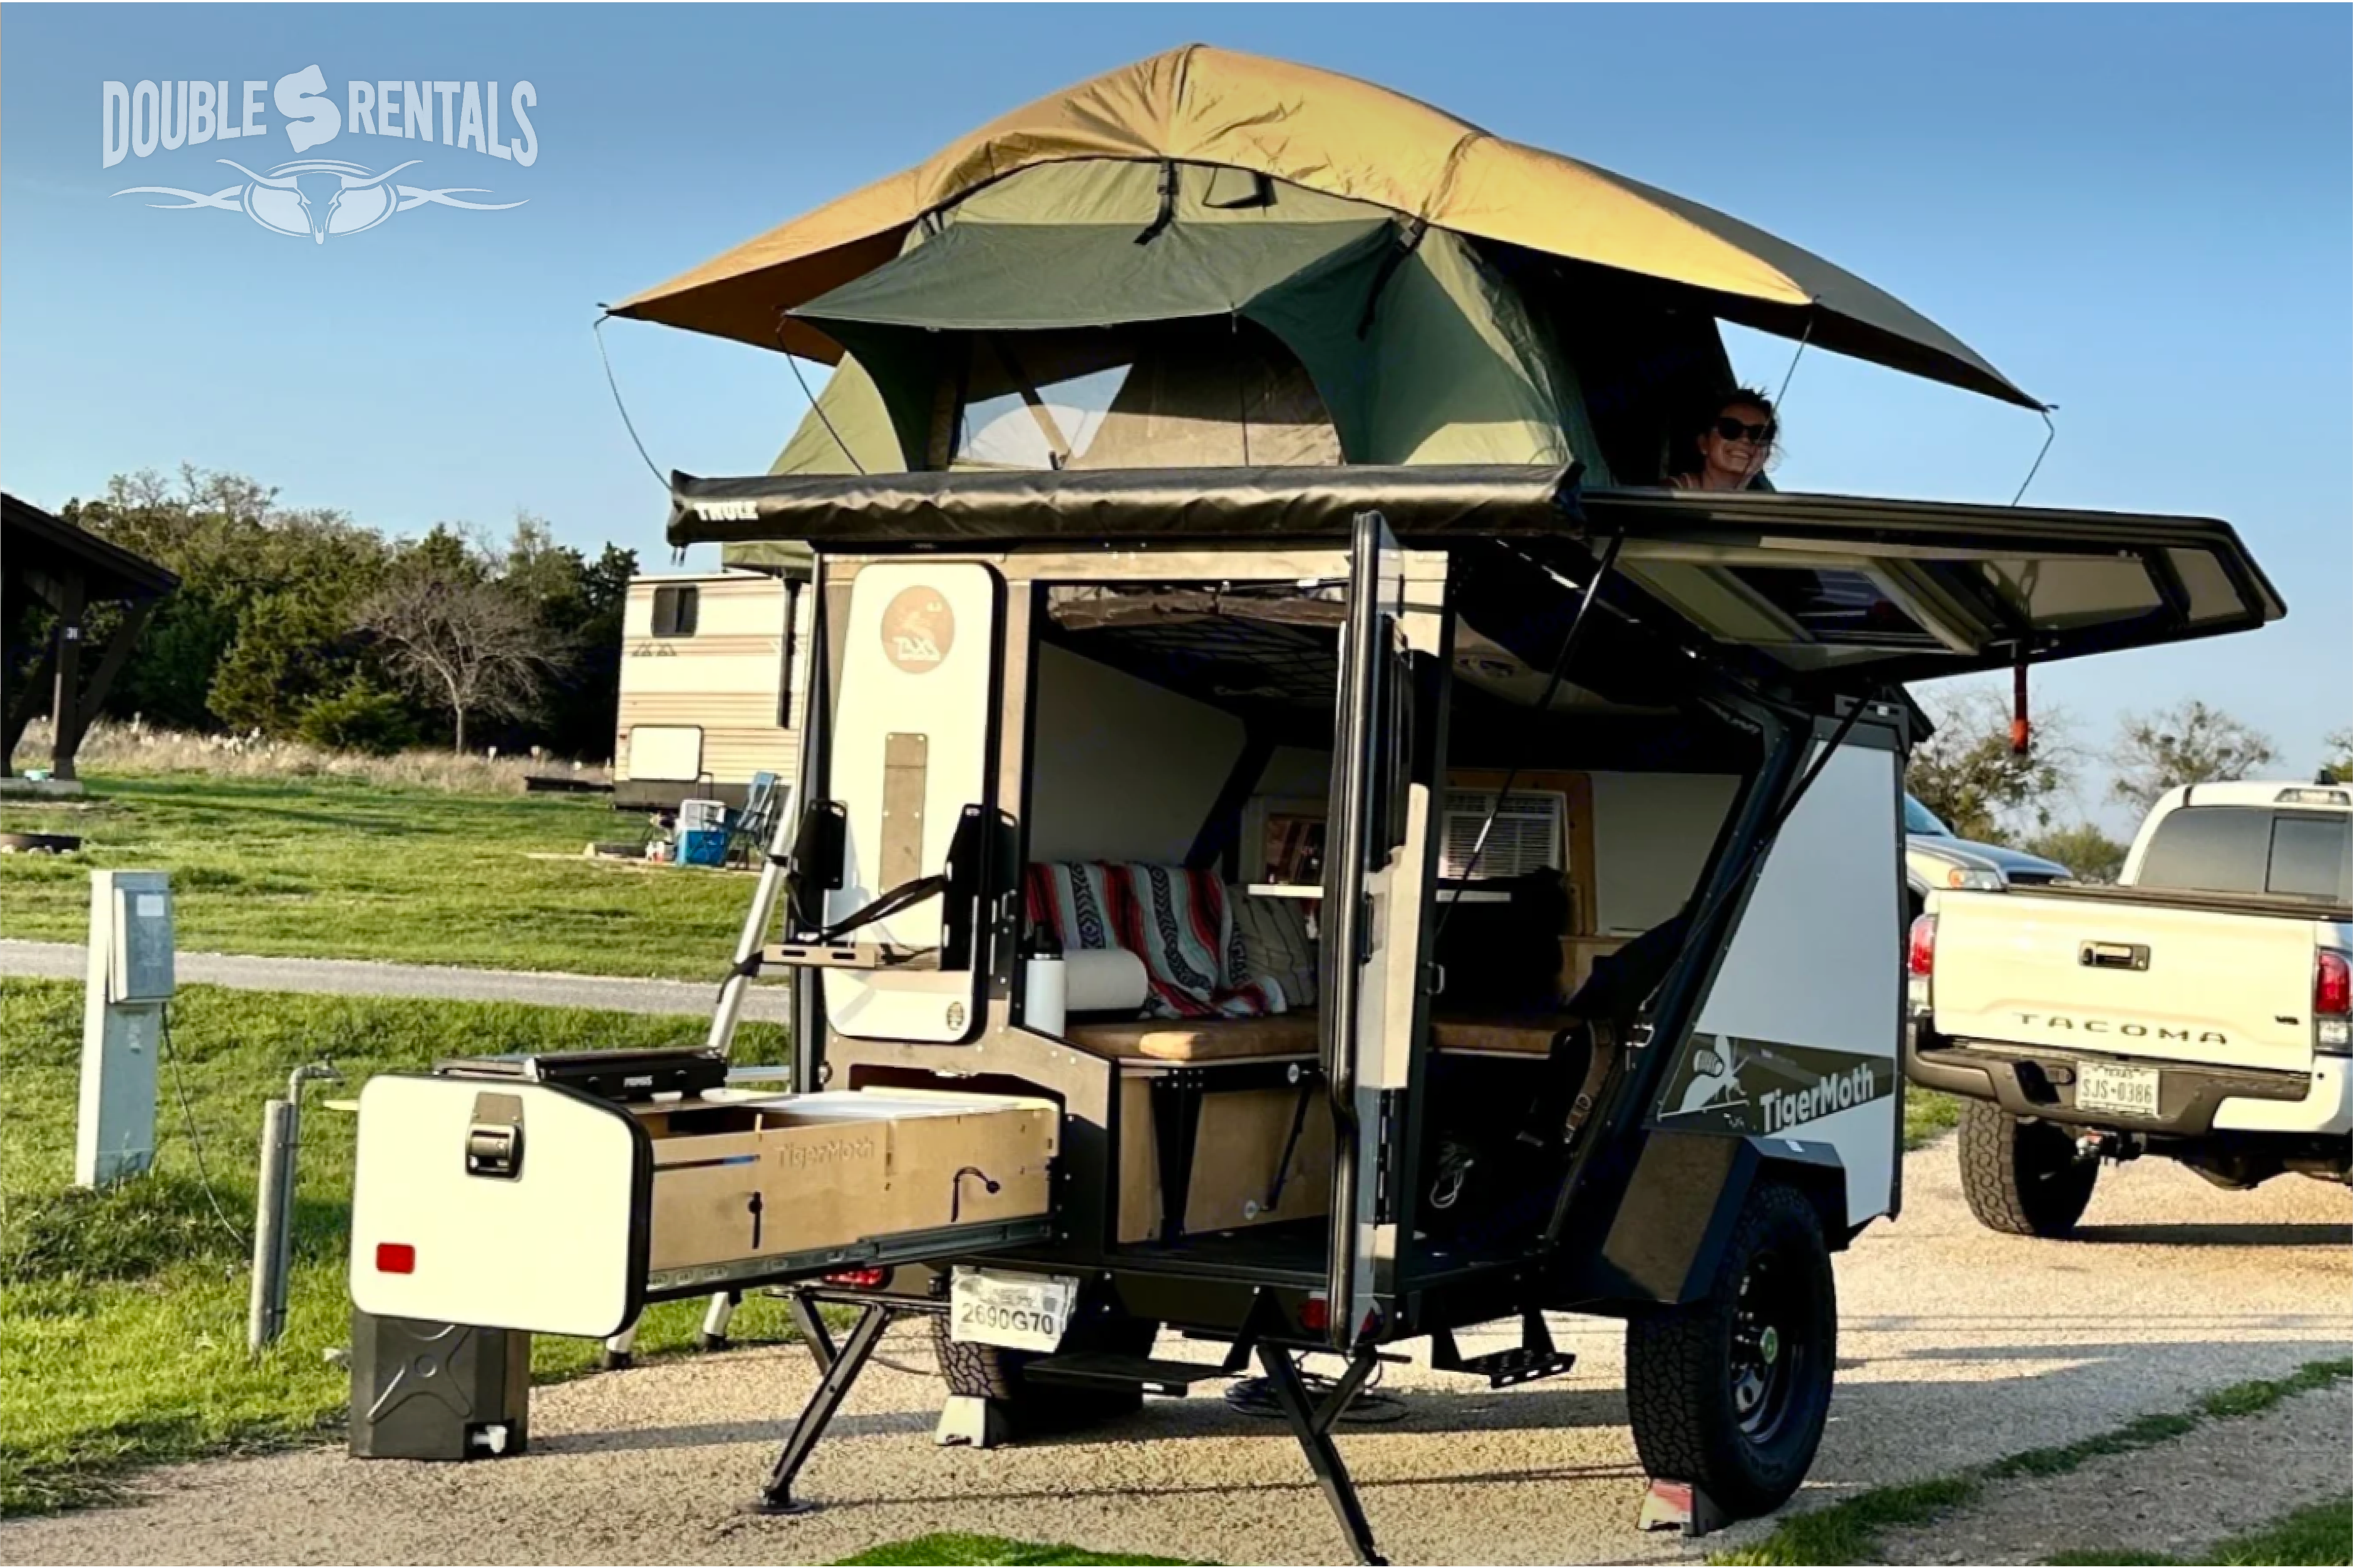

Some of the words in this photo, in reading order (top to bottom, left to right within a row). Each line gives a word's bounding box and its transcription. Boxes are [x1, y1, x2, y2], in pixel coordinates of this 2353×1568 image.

[2012, 1012, 2228, 1046] TACOMA
[1759, 1062, 1874, 1133] TigerMoth
[961, 1302, 1054, 1335] 2690G70
